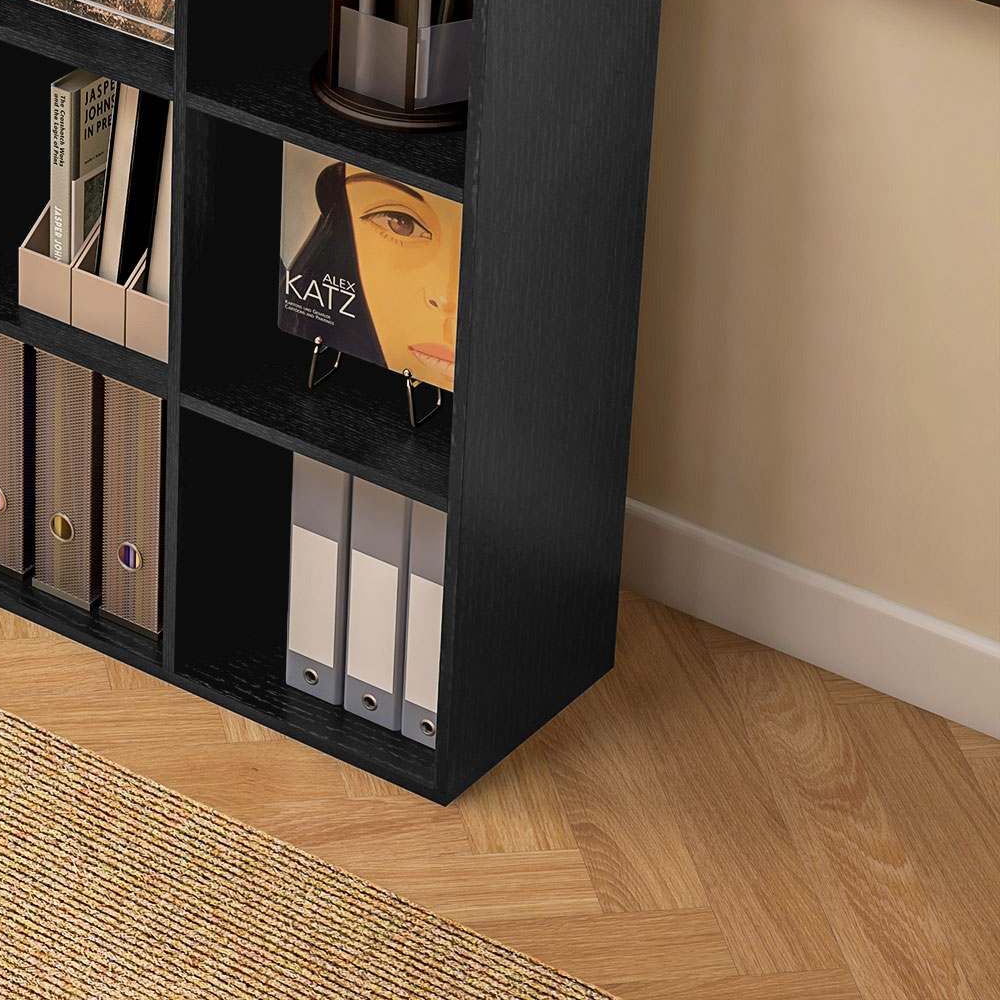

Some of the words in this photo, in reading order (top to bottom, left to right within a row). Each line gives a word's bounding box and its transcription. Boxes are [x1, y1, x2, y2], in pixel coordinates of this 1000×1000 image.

[84, 79, 116, 106] JASPE
[84, 124, 94, 141] IN
[96, 114, 112, 134] PRE
[53, 140, 59, 149] of
[54, 205, 62, 238] JASPER
[54, 238, 62, 262] JOHN
[285, 270, 356, 319] KATZ
[322, 273, 356, 293] ALEX
